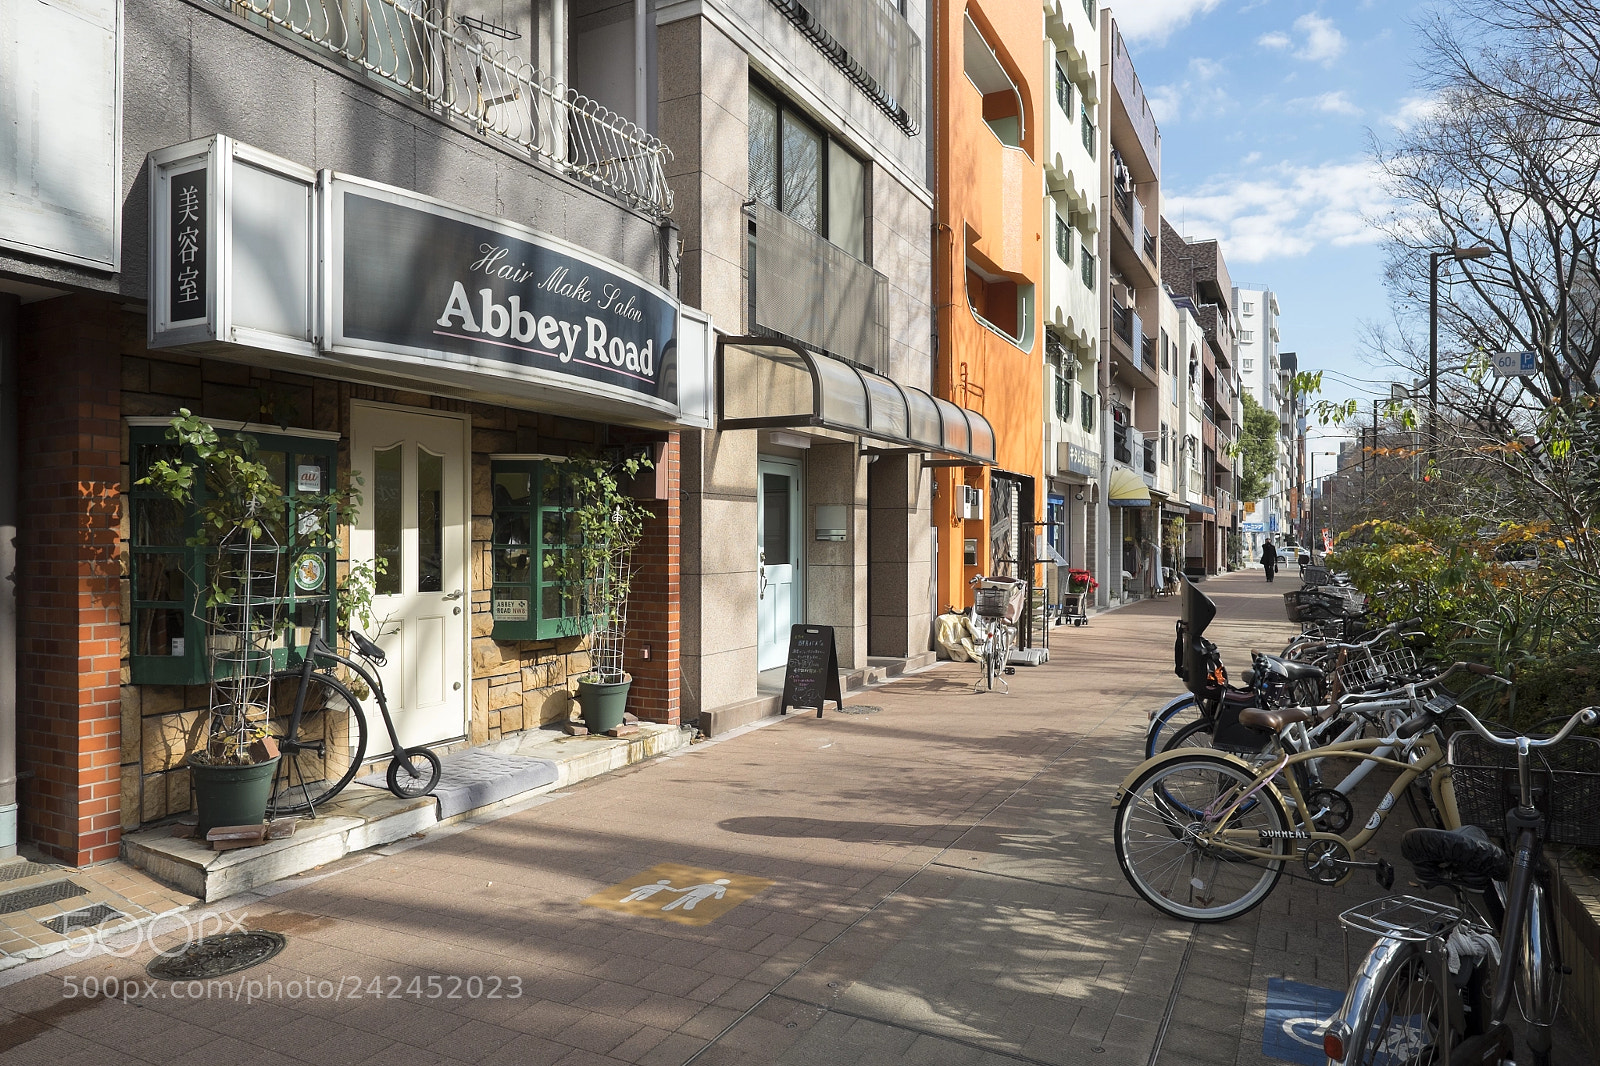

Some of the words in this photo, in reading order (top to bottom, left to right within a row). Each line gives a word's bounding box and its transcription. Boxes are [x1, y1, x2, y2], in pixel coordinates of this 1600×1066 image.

[178, 185, 199, 303] 美容室
[469, 243, 533, 284] Hair
[538, 266, 593, 303] Make
[597, 283, 643, 323] Salon
[436, 281, 582, 363] Abbey
[585, 316, 653, 376] Road
[1524, 353, 1532, 364] P
[301, 472, 318, 481] au
